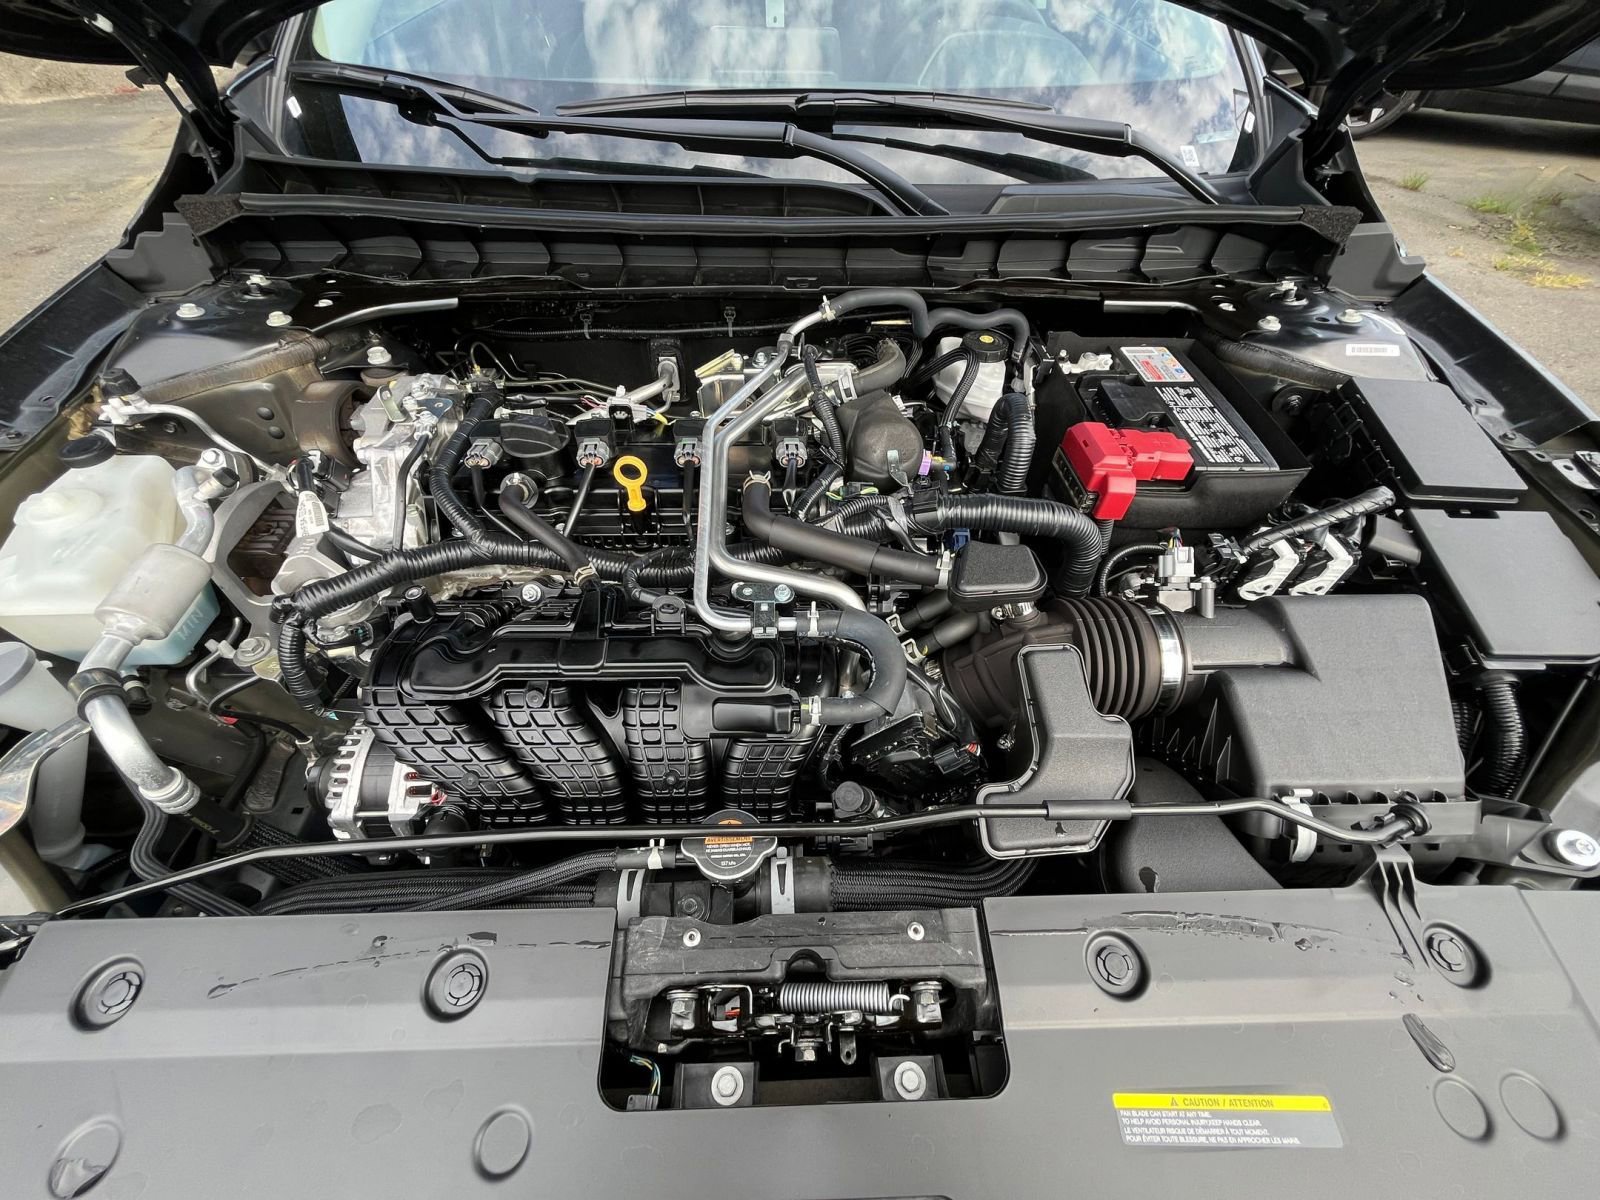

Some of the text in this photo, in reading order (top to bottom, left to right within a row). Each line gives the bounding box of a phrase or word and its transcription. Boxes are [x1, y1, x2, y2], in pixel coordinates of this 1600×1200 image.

[1183, 1098, 1220, 1107] CAUTION
[1229, 1098, 1274, 1108] ATTENTION
[1142, 1134, 1161, 1142] ÉVITER
